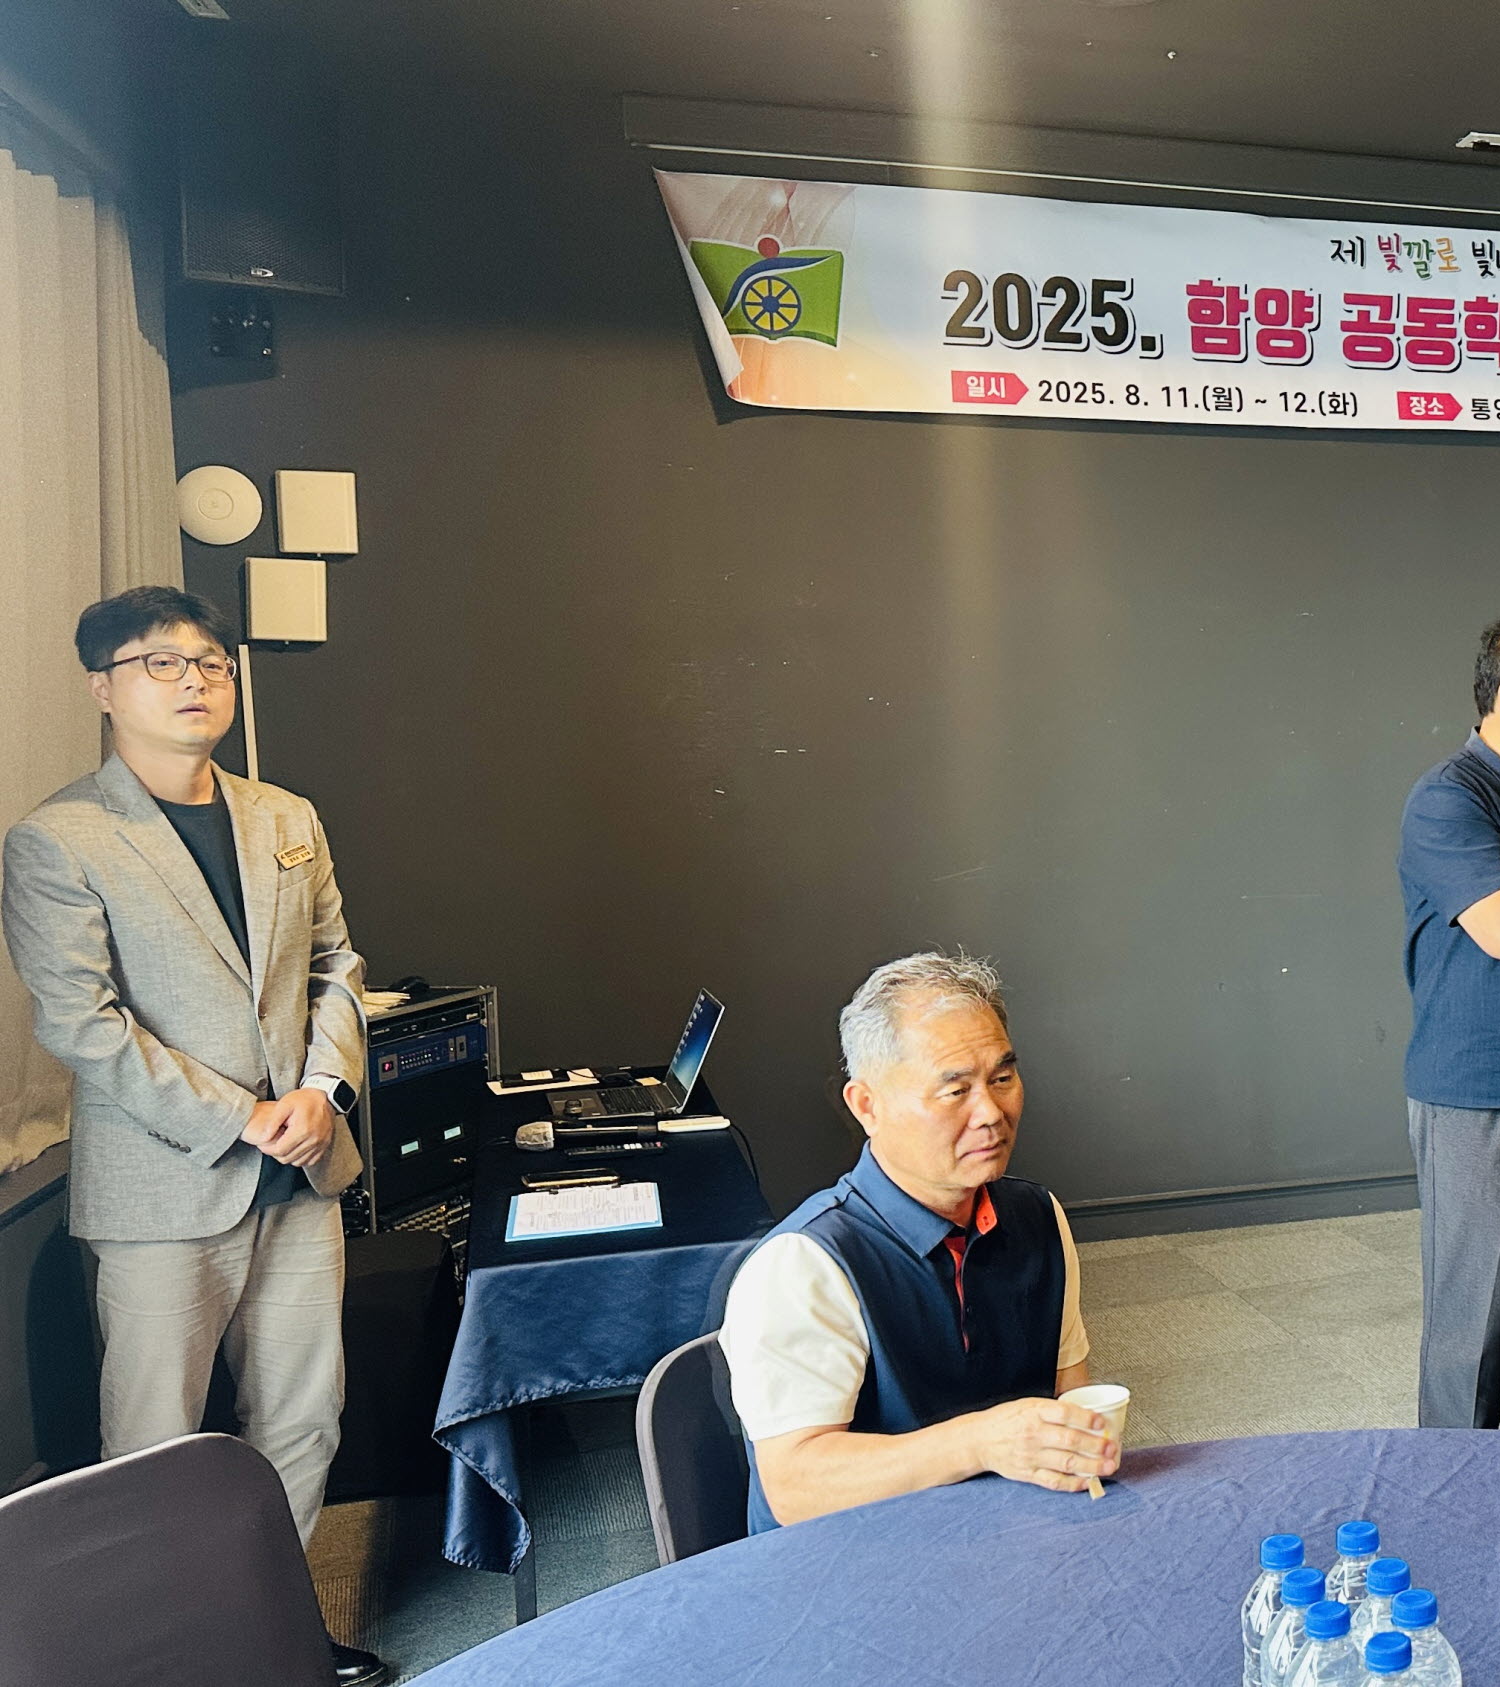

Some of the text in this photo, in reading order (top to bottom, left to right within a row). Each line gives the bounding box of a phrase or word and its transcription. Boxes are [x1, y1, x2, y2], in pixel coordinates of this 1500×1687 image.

[1330, 236, 1365, 267] 제
[1377, 233, 1461, 280] 빛깔로
[940, 269, 1163, 358] 2025.
[1186, 276, 1320, 366] 함양
[966, 375, 1006, 399] 일시
[1038, 380, 1114, 405] 2025.
[1125, 385, 1149, 407] 8.
[1161, 385, 1244, 413] 11.(월)
[1279, 391, 1359, 418] 12.(화)
[1409, 396, 1445, 416] 장소
